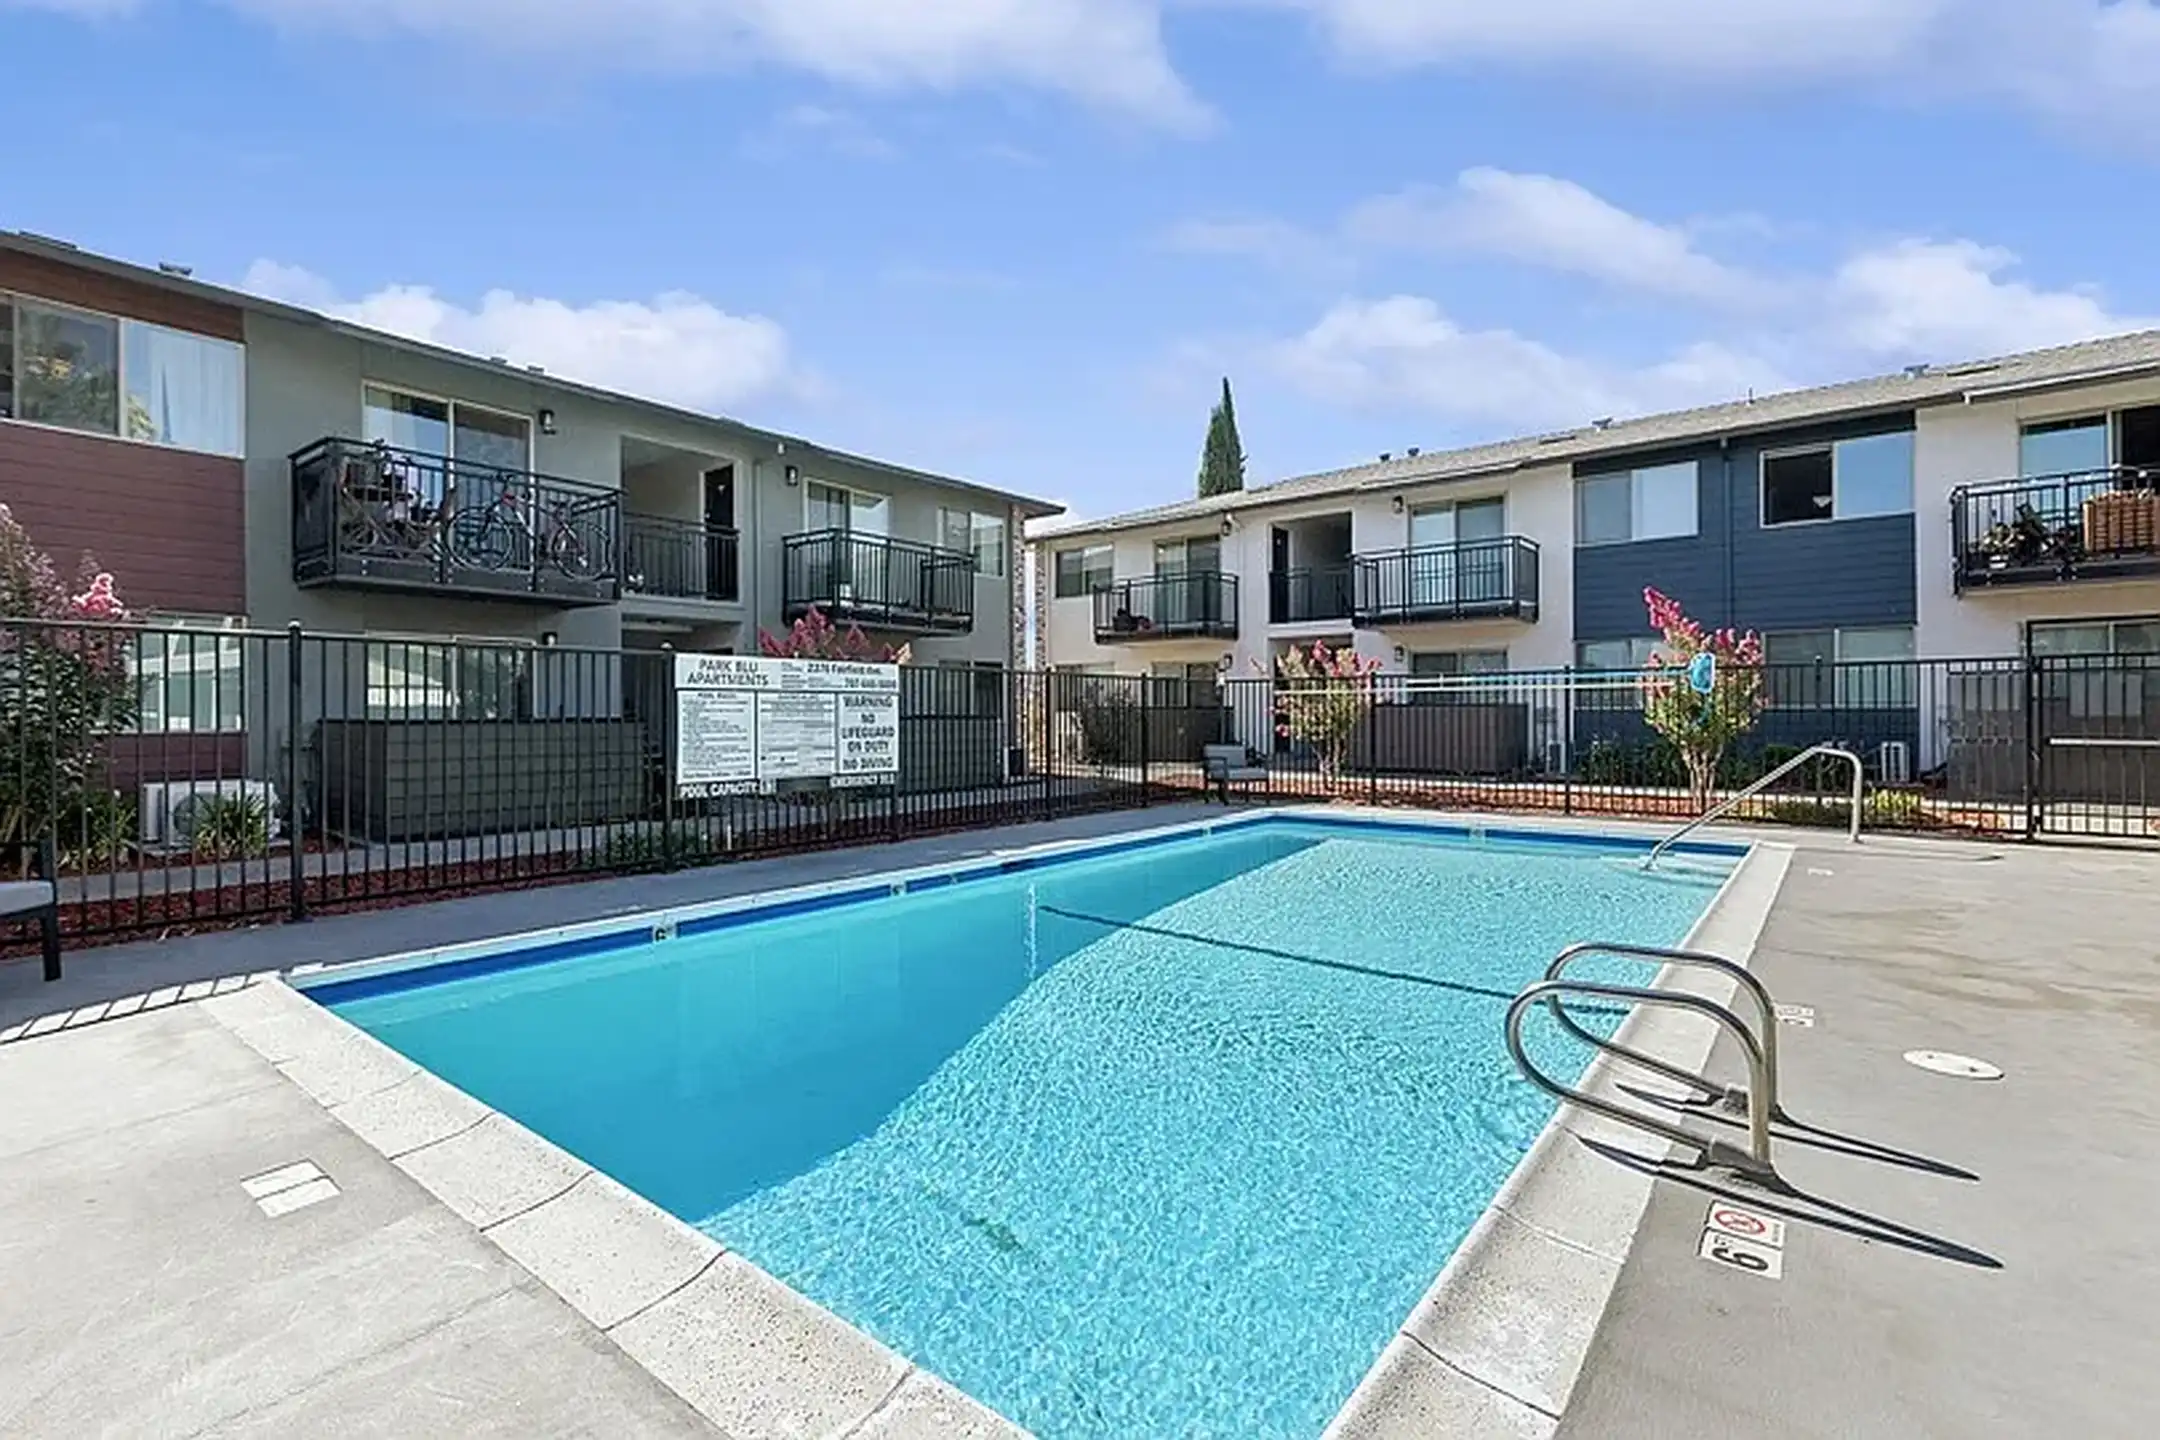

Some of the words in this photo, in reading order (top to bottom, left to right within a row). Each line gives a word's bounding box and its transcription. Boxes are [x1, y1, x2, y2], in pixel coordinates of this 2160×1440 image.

[699, 659, 732, 672] PARK
[735, 661, 758, 673] BLU
[687, 672, 769, 685] APARTMENTS
[842, 695, 892, 708] WARNING
[861, 714, 875, 724] NO
[841, 727, 895, 739] LIFEGUARD
[847, 741, 861, 753] ON
[864, 740, 888, 753] DUTY
[843, 758, 858, 770] NO
[861, 757, 892, 769] DIVING
[680, 784, 708, 798] POOL
[710, 780, 758, 796] CAPACITY
[1712, 1251, 1769, 1271] 6
